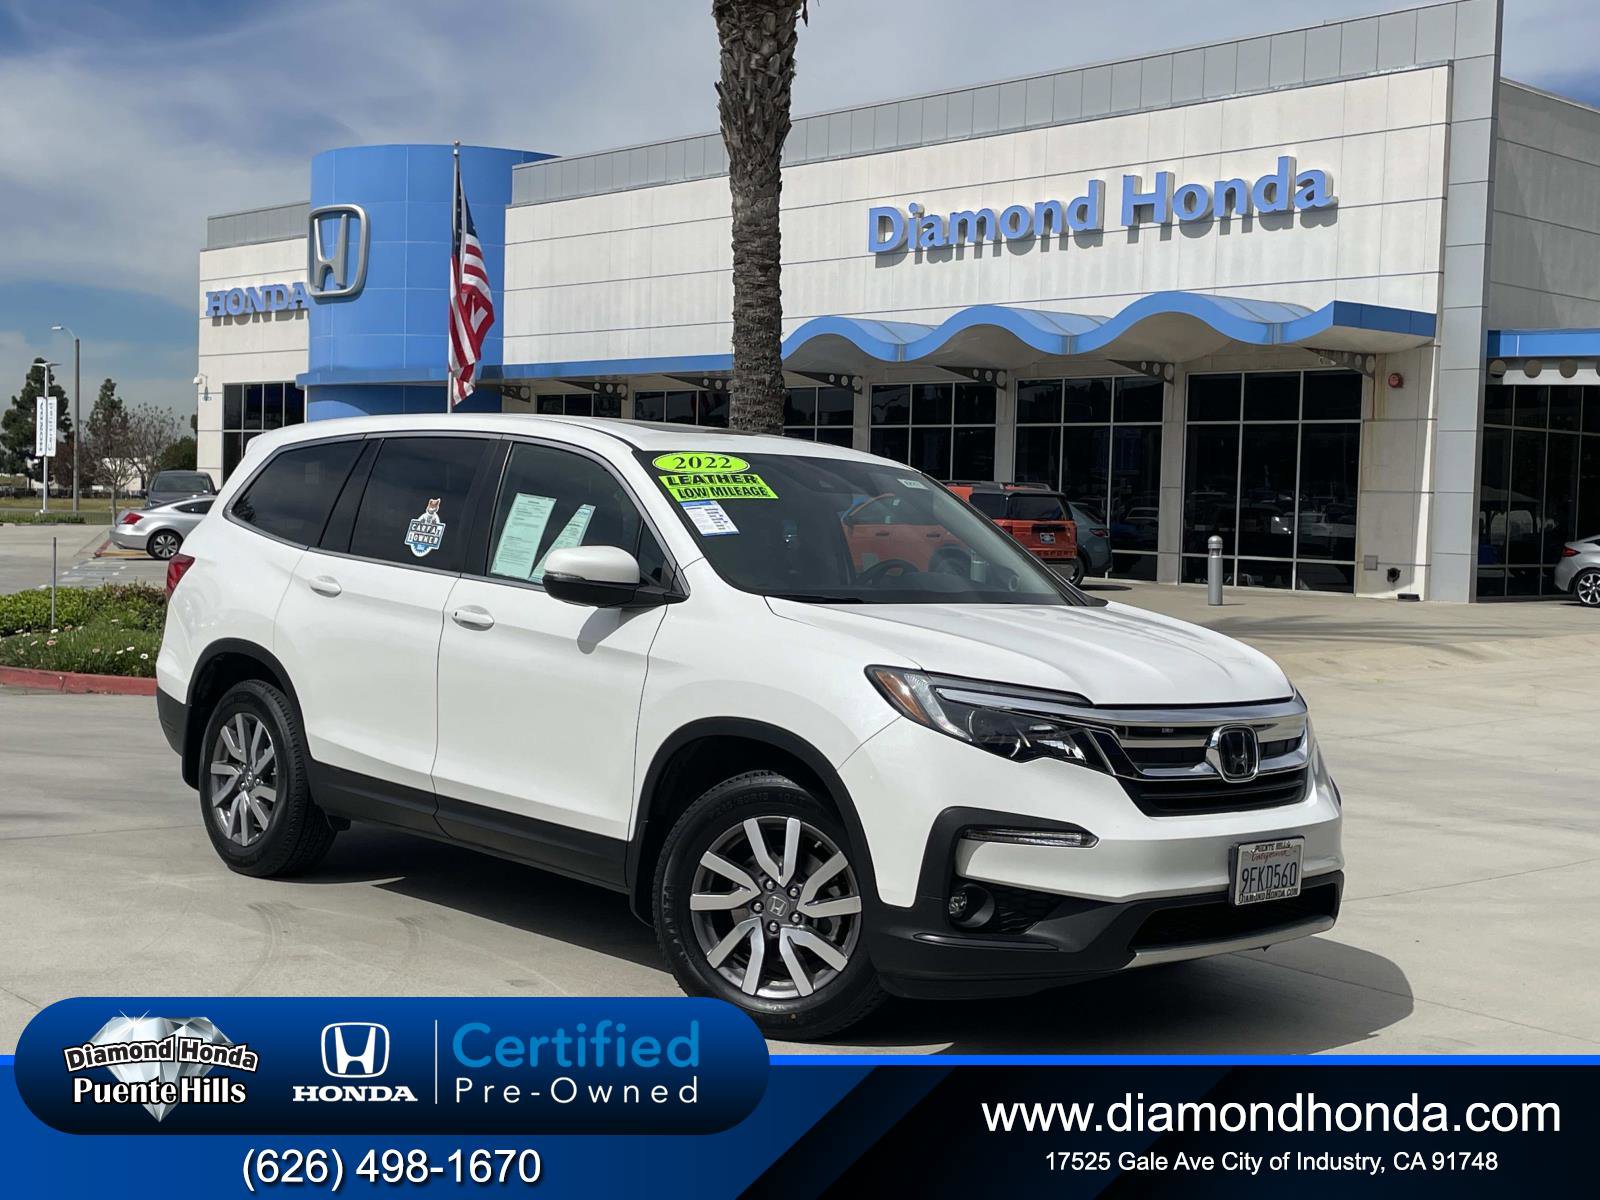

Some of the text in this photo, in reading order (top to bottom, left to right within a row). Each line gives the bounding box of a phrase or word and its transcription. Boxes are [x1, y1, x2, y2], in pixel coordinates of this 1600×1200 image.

[868, 156, 1334, 253] Diamond Honda
[206, 282, 308, 317] HONDA
[672, 456, 732, 469] 2022
[666, 474, 759, 486] LEATHER
[677, 485, 771, 499] LOW MILEAGE
[1241, 861, 1298, 893] 9FKD560
